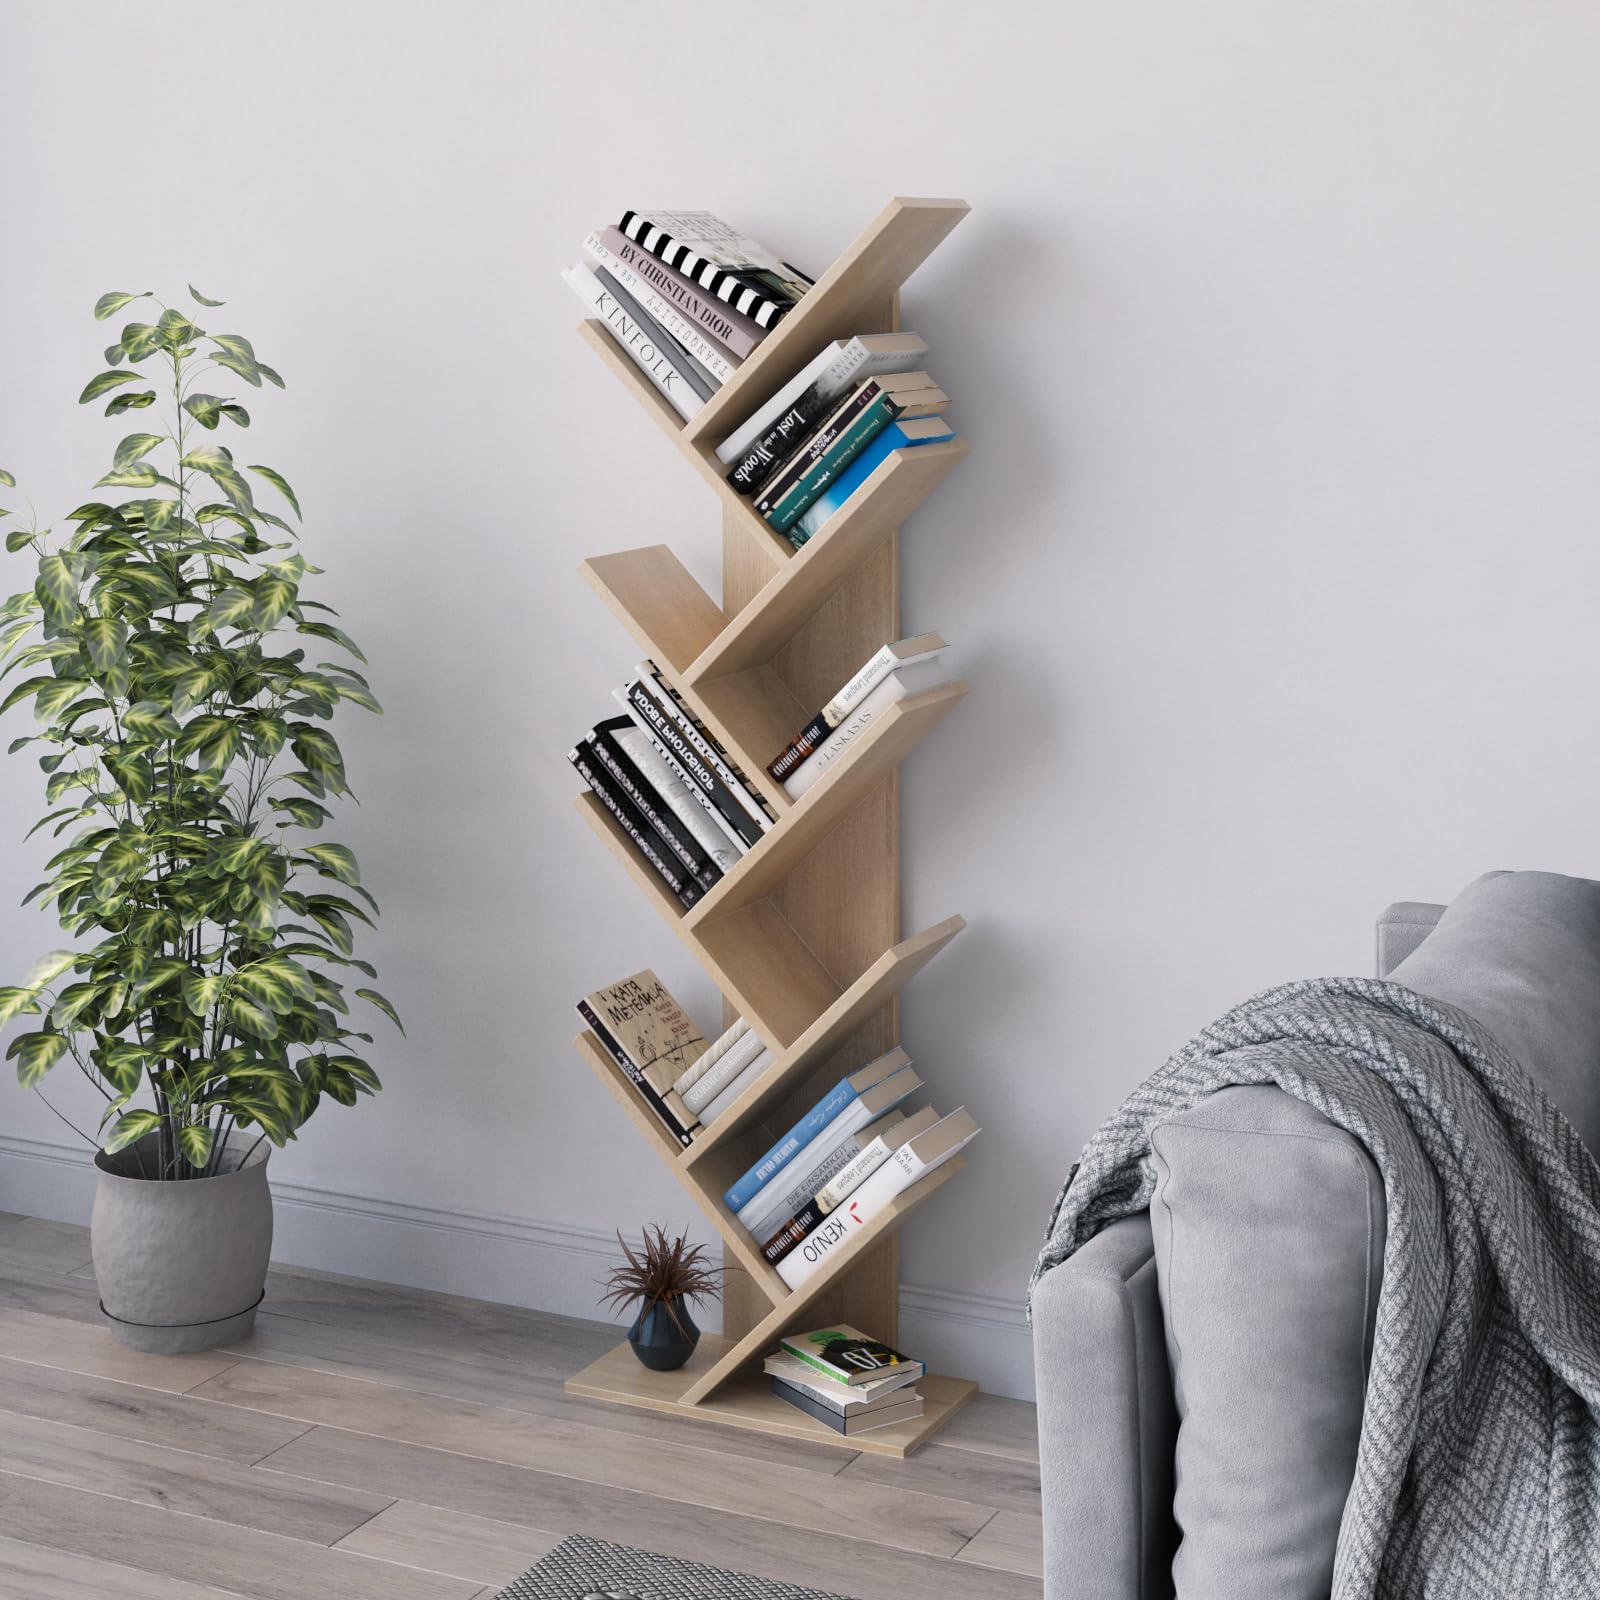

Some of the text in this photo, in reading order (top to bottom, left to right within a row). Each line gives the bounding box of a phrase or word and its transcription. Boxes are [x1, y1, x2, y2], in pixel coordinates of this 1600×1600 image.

[620, 244, 733, 340] BY CHRISTIAN DIOR
[595, 292, 679, 390] KINFOLK
[646, 295, 726, 376] TRANQUILITY
[777, 409, 805, 439] Lost
[734, 446, 773, 483] Woods
[610, 980, 642, 1006] КАТЯ
[787, 1190, 801, 1206] DIE
[800, 1146, 848, 1194] EINSAMKEIT
[792, 1194, 809, 1212] DER
[803, 1218, 847, 1263] KENJO
